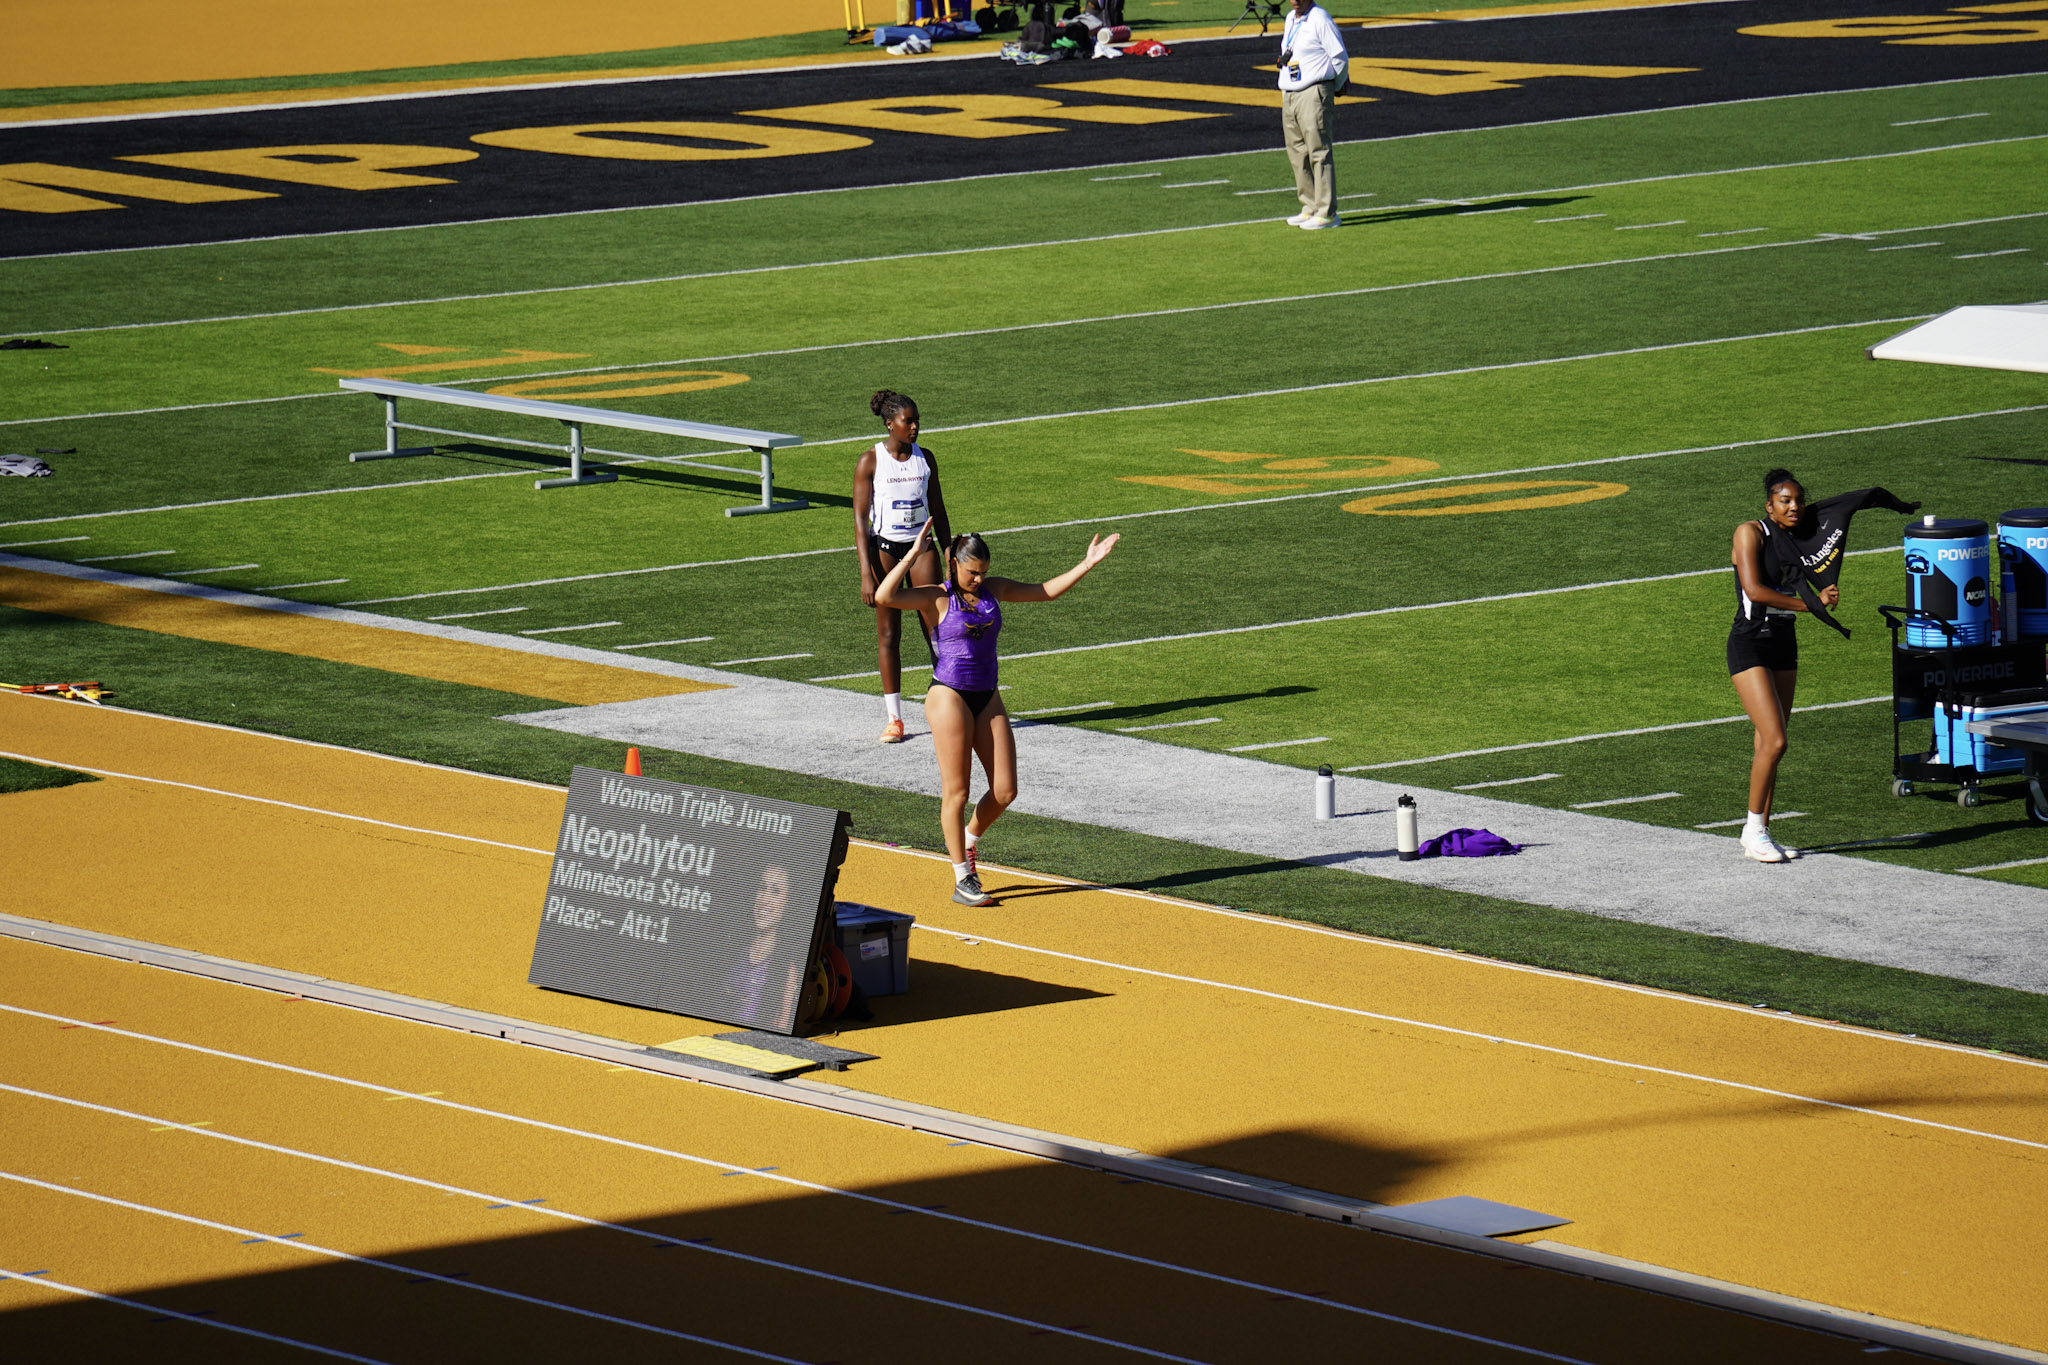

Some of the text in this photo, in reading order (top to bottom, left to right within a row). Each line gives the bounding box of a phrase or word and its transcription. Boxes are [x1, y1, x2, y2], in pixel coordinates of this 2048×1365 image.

[1114, 455, 1630, 517] 20
[1809, 528, 1843, 565] Angeles
[1828, 547, 1840, 562] FIELD
[1965, 589, 1987, 601] NCAA
[600, 777, 674, 815] Women
[680, 790, 735, 828] Triple
[561, 814, 715, 878] Neophytou
[554, 859, 712, 912] Minnesota State
[618, 909, 671, 944] Att:1
